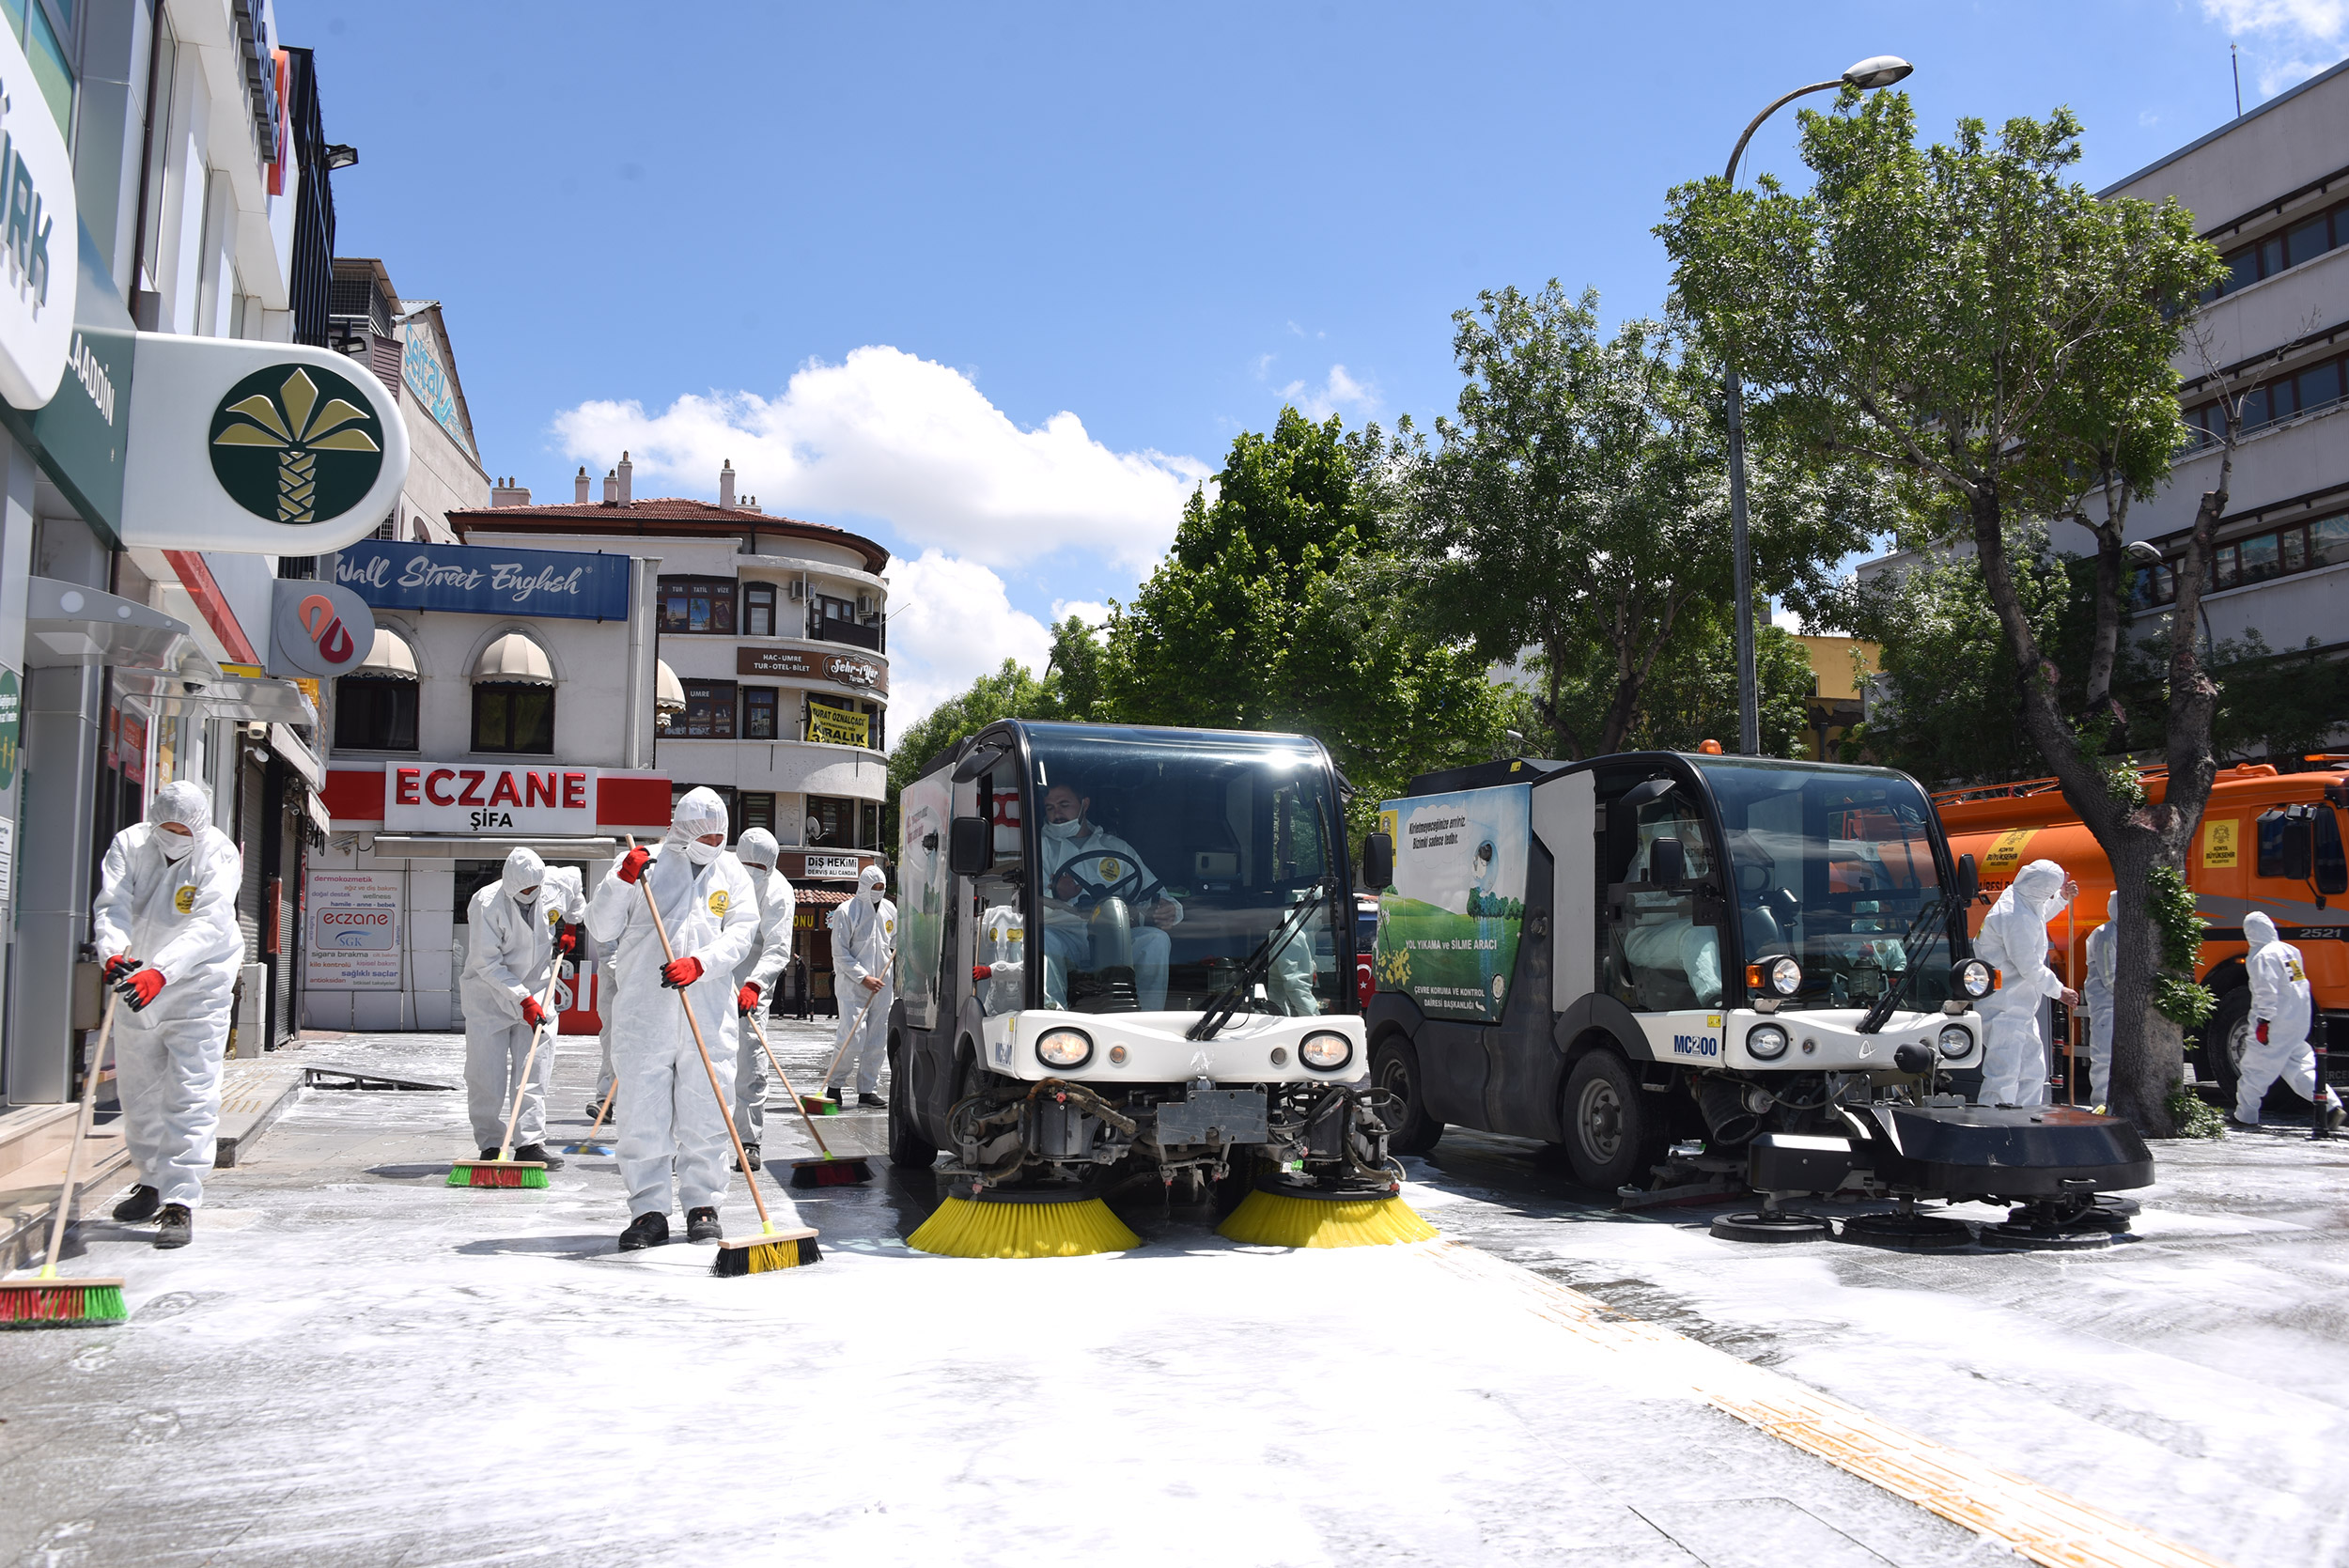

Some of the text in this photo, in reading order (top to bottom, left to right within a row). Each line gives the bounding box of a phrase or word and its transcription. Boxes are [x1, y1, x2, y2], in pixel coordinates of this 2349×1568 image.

[335, 552, 583, 602] Wall Street English
[396, 768, 587, 809] ECZANE
[470, 808, 514, 831] ŞİFA
[1428, 834, 1444, 847] sadece
[323, 912, 389, 925] eczane
[2299, 928, 2341, 938] 2521
[339, 937, 362, 947] SGK
[1405, 938, 1498, 950] YOL YIKAMA ve SİLME ARACI
[311, 951, 335, 959] sigara
[341, 970, 370, 978] sağlıklı
[1414, 986, 1486, 997] ÇEVRE KORUMA VE KONTROL
[1673, 1034, 1718, 1056] MC200
